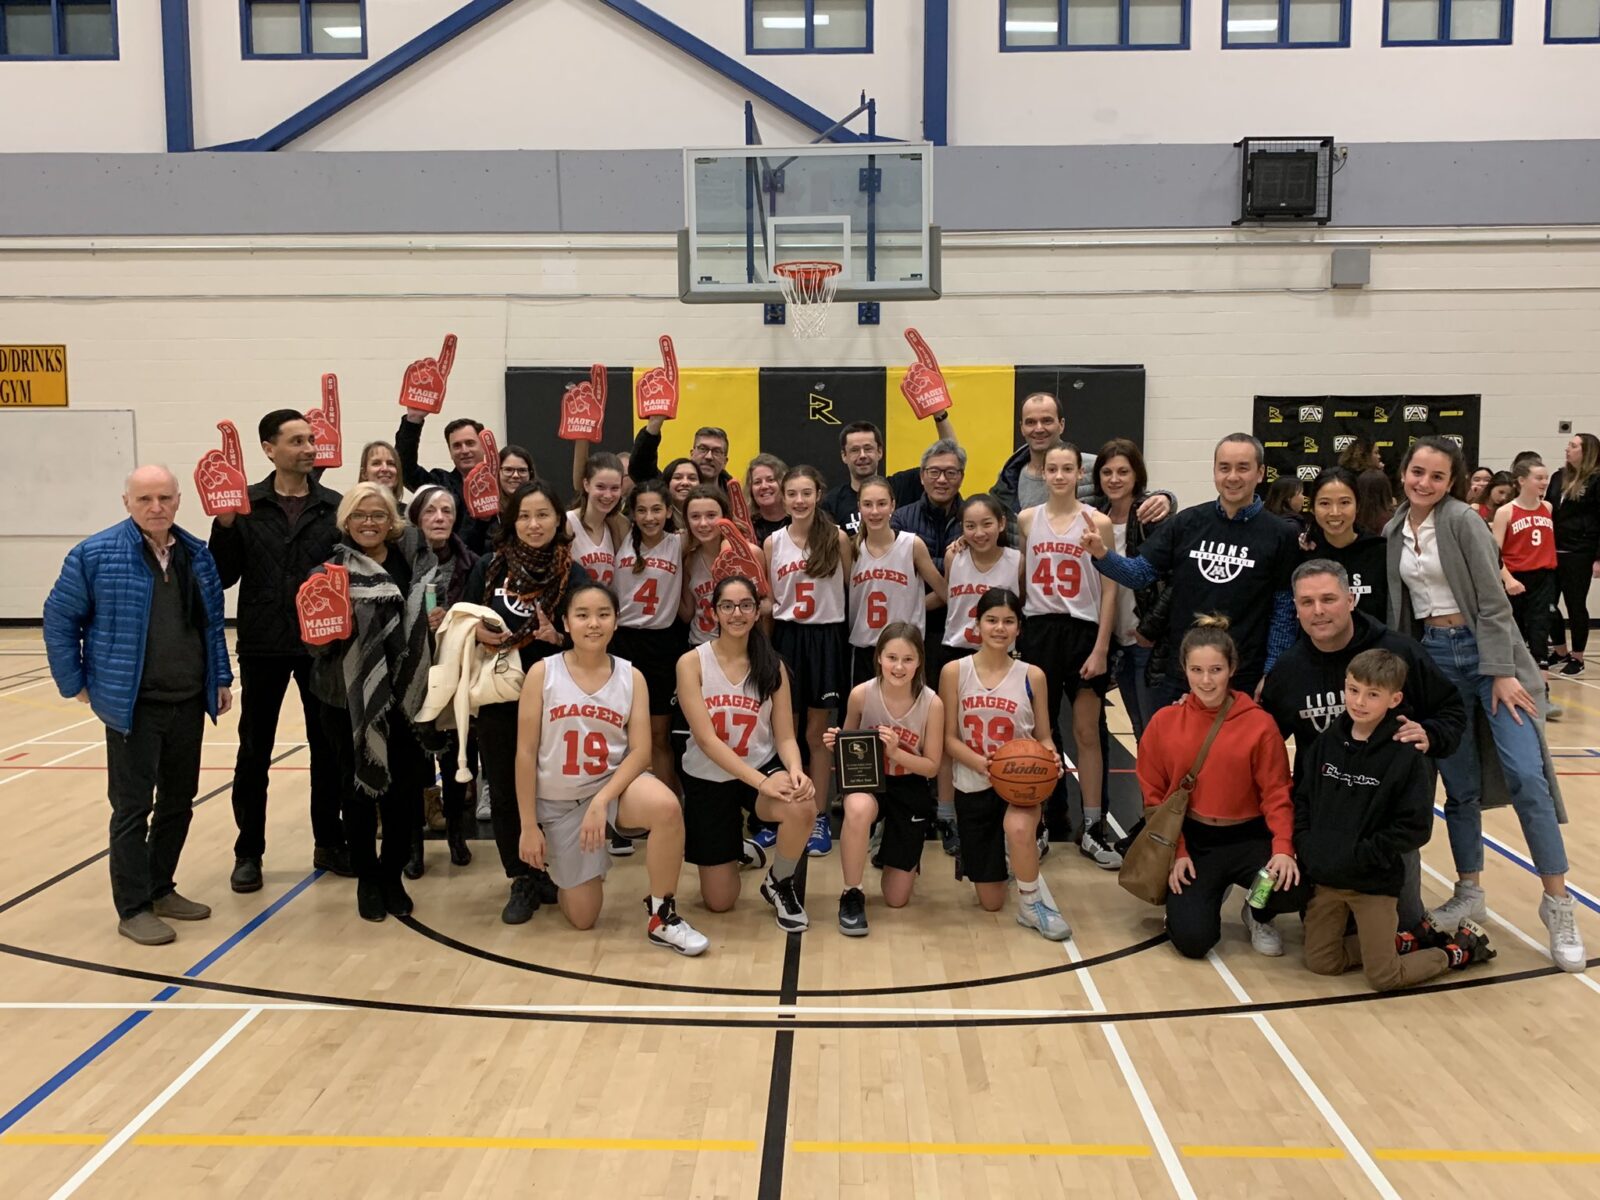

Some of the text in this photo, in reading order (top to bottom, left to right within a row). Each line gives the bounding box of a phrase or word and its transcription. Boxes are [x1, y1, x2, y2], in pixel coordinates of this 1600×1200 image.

[0, 379, 32, 403] GYM
[408, 386, 439, 400] MAGEE
[408, 393, 435, 405] LIONS
[916, 387, 944, 403] MAGEE
[643, 399, 671, 408] MAGEE
[644, 404, 669, 412] LIONS
[810, 393, 842, 424] R
[921, 394, 945, 409] LIONS
[567, 417, 596, 427] MAGEE
[1300, 407, 1323, 422] PAC
[1404, 406, 1427, 421] PAC
[567, 424, 593, 433] LIONS
[316, 451, 335, 459] ONS
[207, 489, 243, 501] MAGEE
[211, 498, 242, 509] LIONS
[1511, 516, 1532, 535] HOLY
[1531, 529, 1541, 546] 9
[1032, 542, 1085, 559] MAGEE
[1200, 540, 1249, 559] LIONS
[619, 556, 677, 575] MGEE
[1194, 552, 1249, 566] BASKETBALL
[777, 560, 807, 582] MAG
[853, 568, 908, 588] MAGEE
[1032, 557, 1081, 599] 49
[633, 578, 659, 616] 4
[950, 583, 990, 598] MAG
[793, 582, 816, 620] 5
[866, 591, 888, 629] 6
[306, 616, 344, 628] MAGEE
[309, 625, 342, 638] LIONS
[705, 694, 761, 713] MAGEE
[962, 696, 1018, 714] MAGEE
[550, 703, 624, 729] MAGEE
[711, 711, 757, 757] 47
[963, 714, 1014, 756] 39
[562, 730, 609, 776] 19
